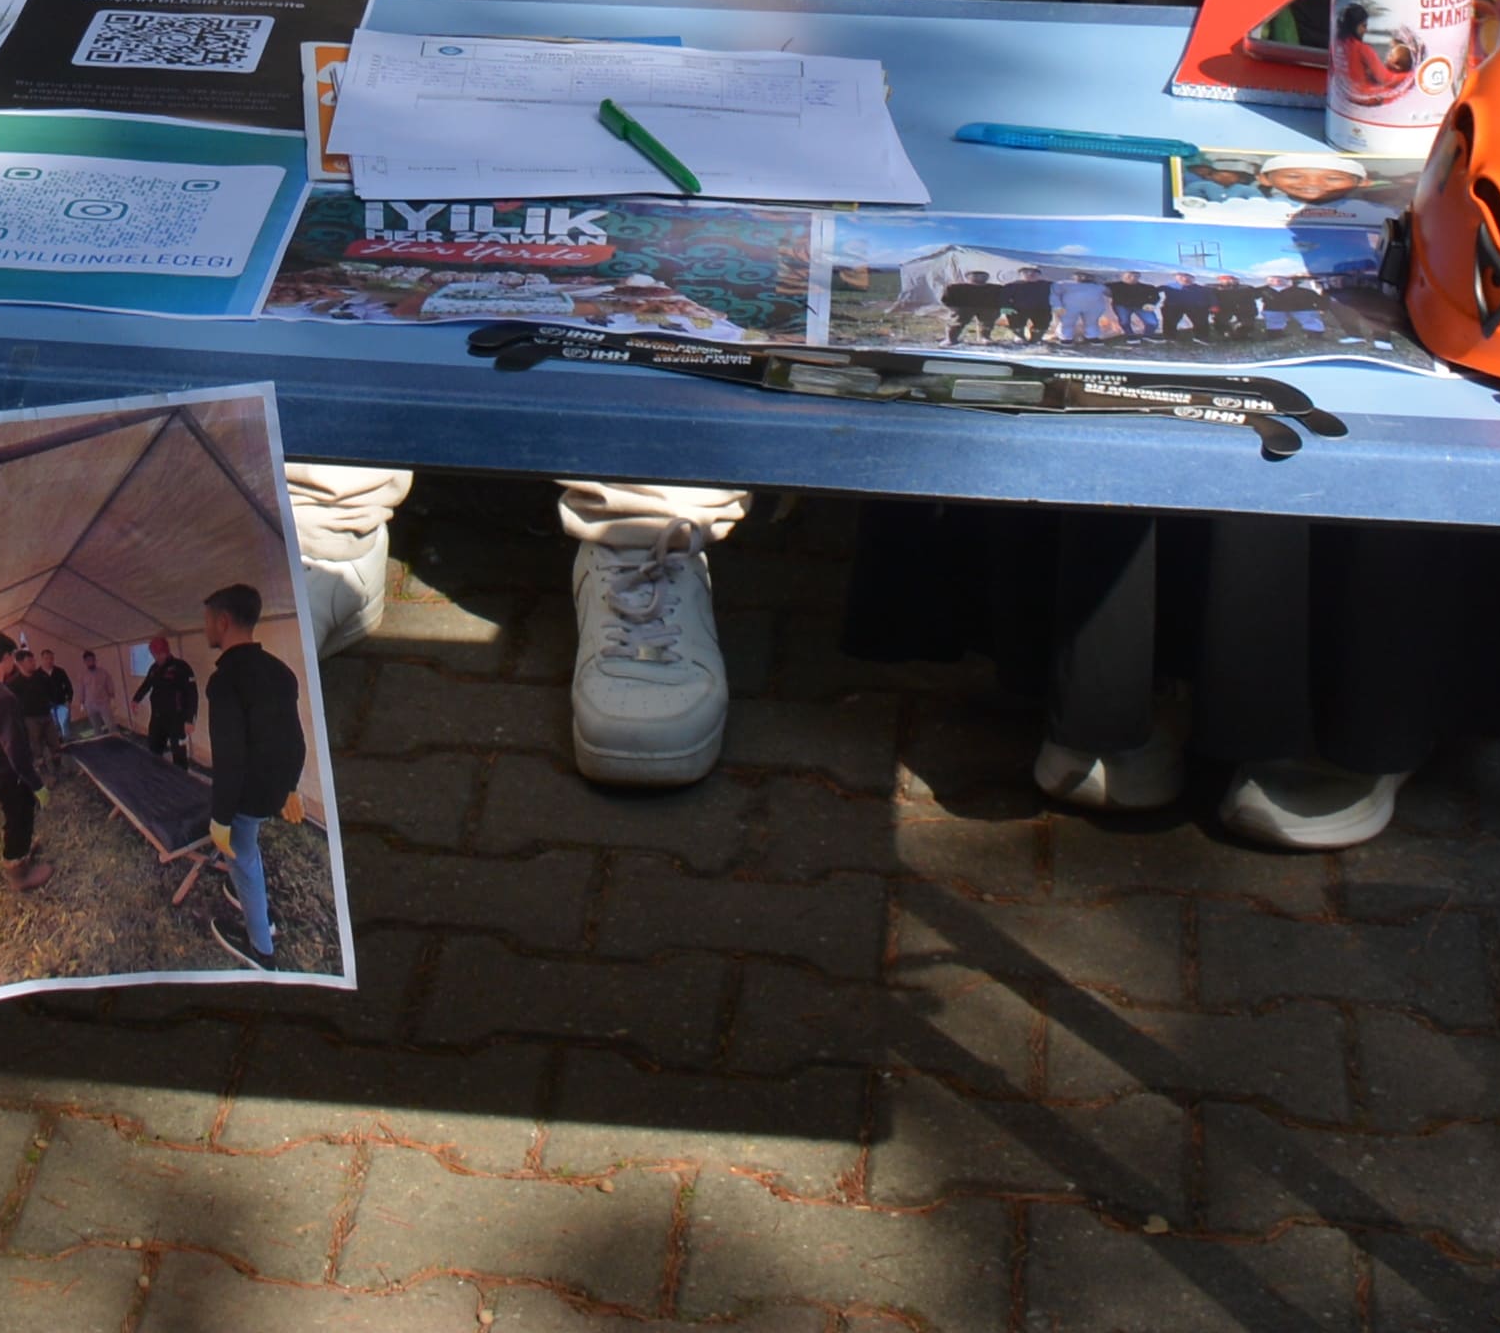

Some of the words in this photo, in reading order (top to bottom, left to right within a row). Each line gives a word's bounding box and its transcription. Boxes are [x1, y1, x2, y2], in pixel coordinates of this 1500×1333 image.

[1419, 4, 1473, 30] EMANE
[365, 228, 444, 243] HER
[454, 231, 607, 246] ZAMAN
